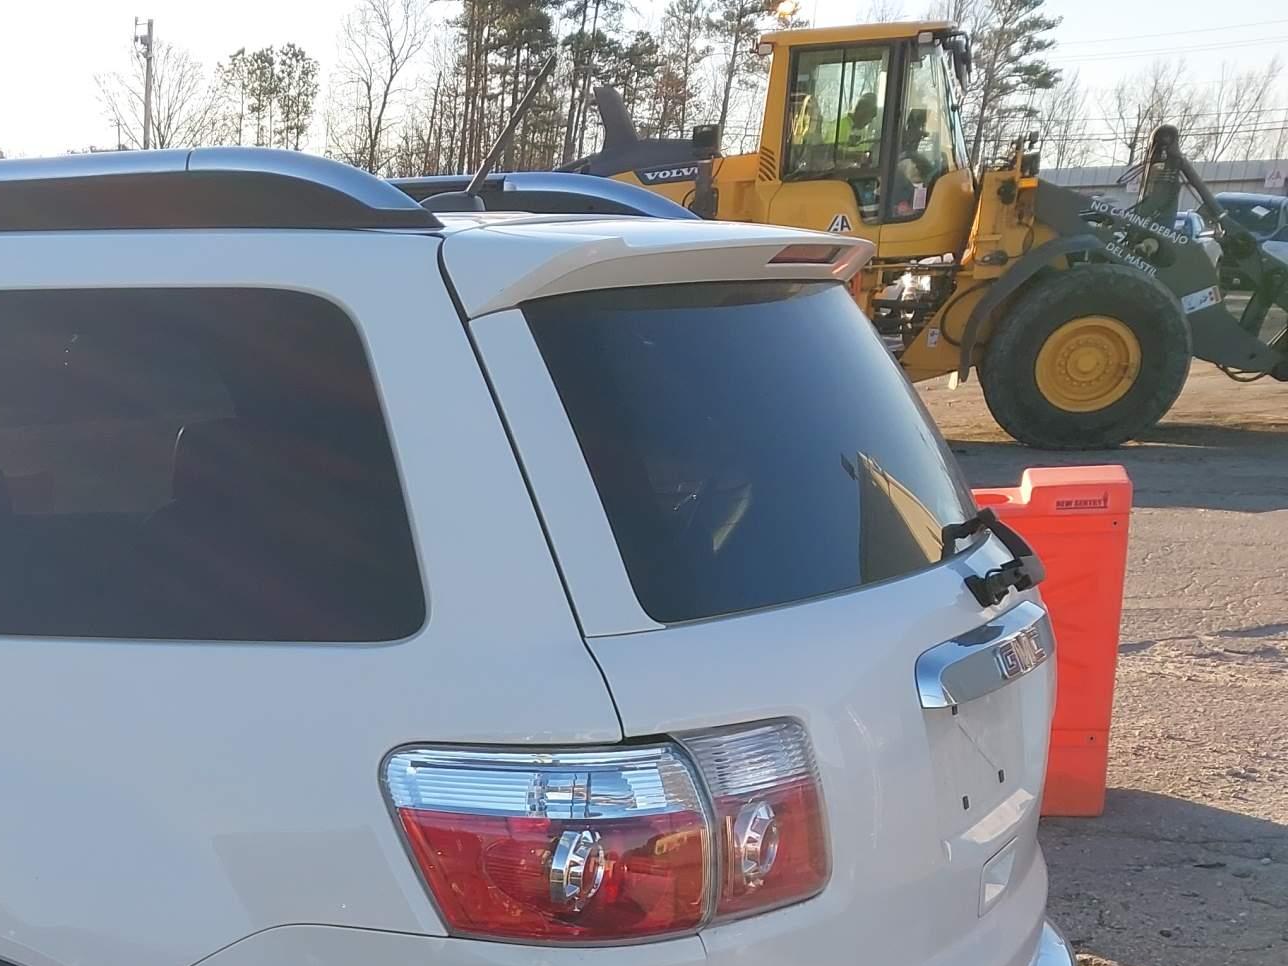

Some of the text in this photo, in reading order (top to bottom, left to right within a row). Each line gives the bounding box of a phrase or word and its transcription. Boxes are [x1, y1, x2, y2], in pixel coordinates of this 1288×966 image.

[1090, 200, 1109, 213] NO
[1149, 222, 1189, 245] DEBAJO
[1105, 242, 1124, 258] DEL
[998, 626, 1047, 680] GMC
